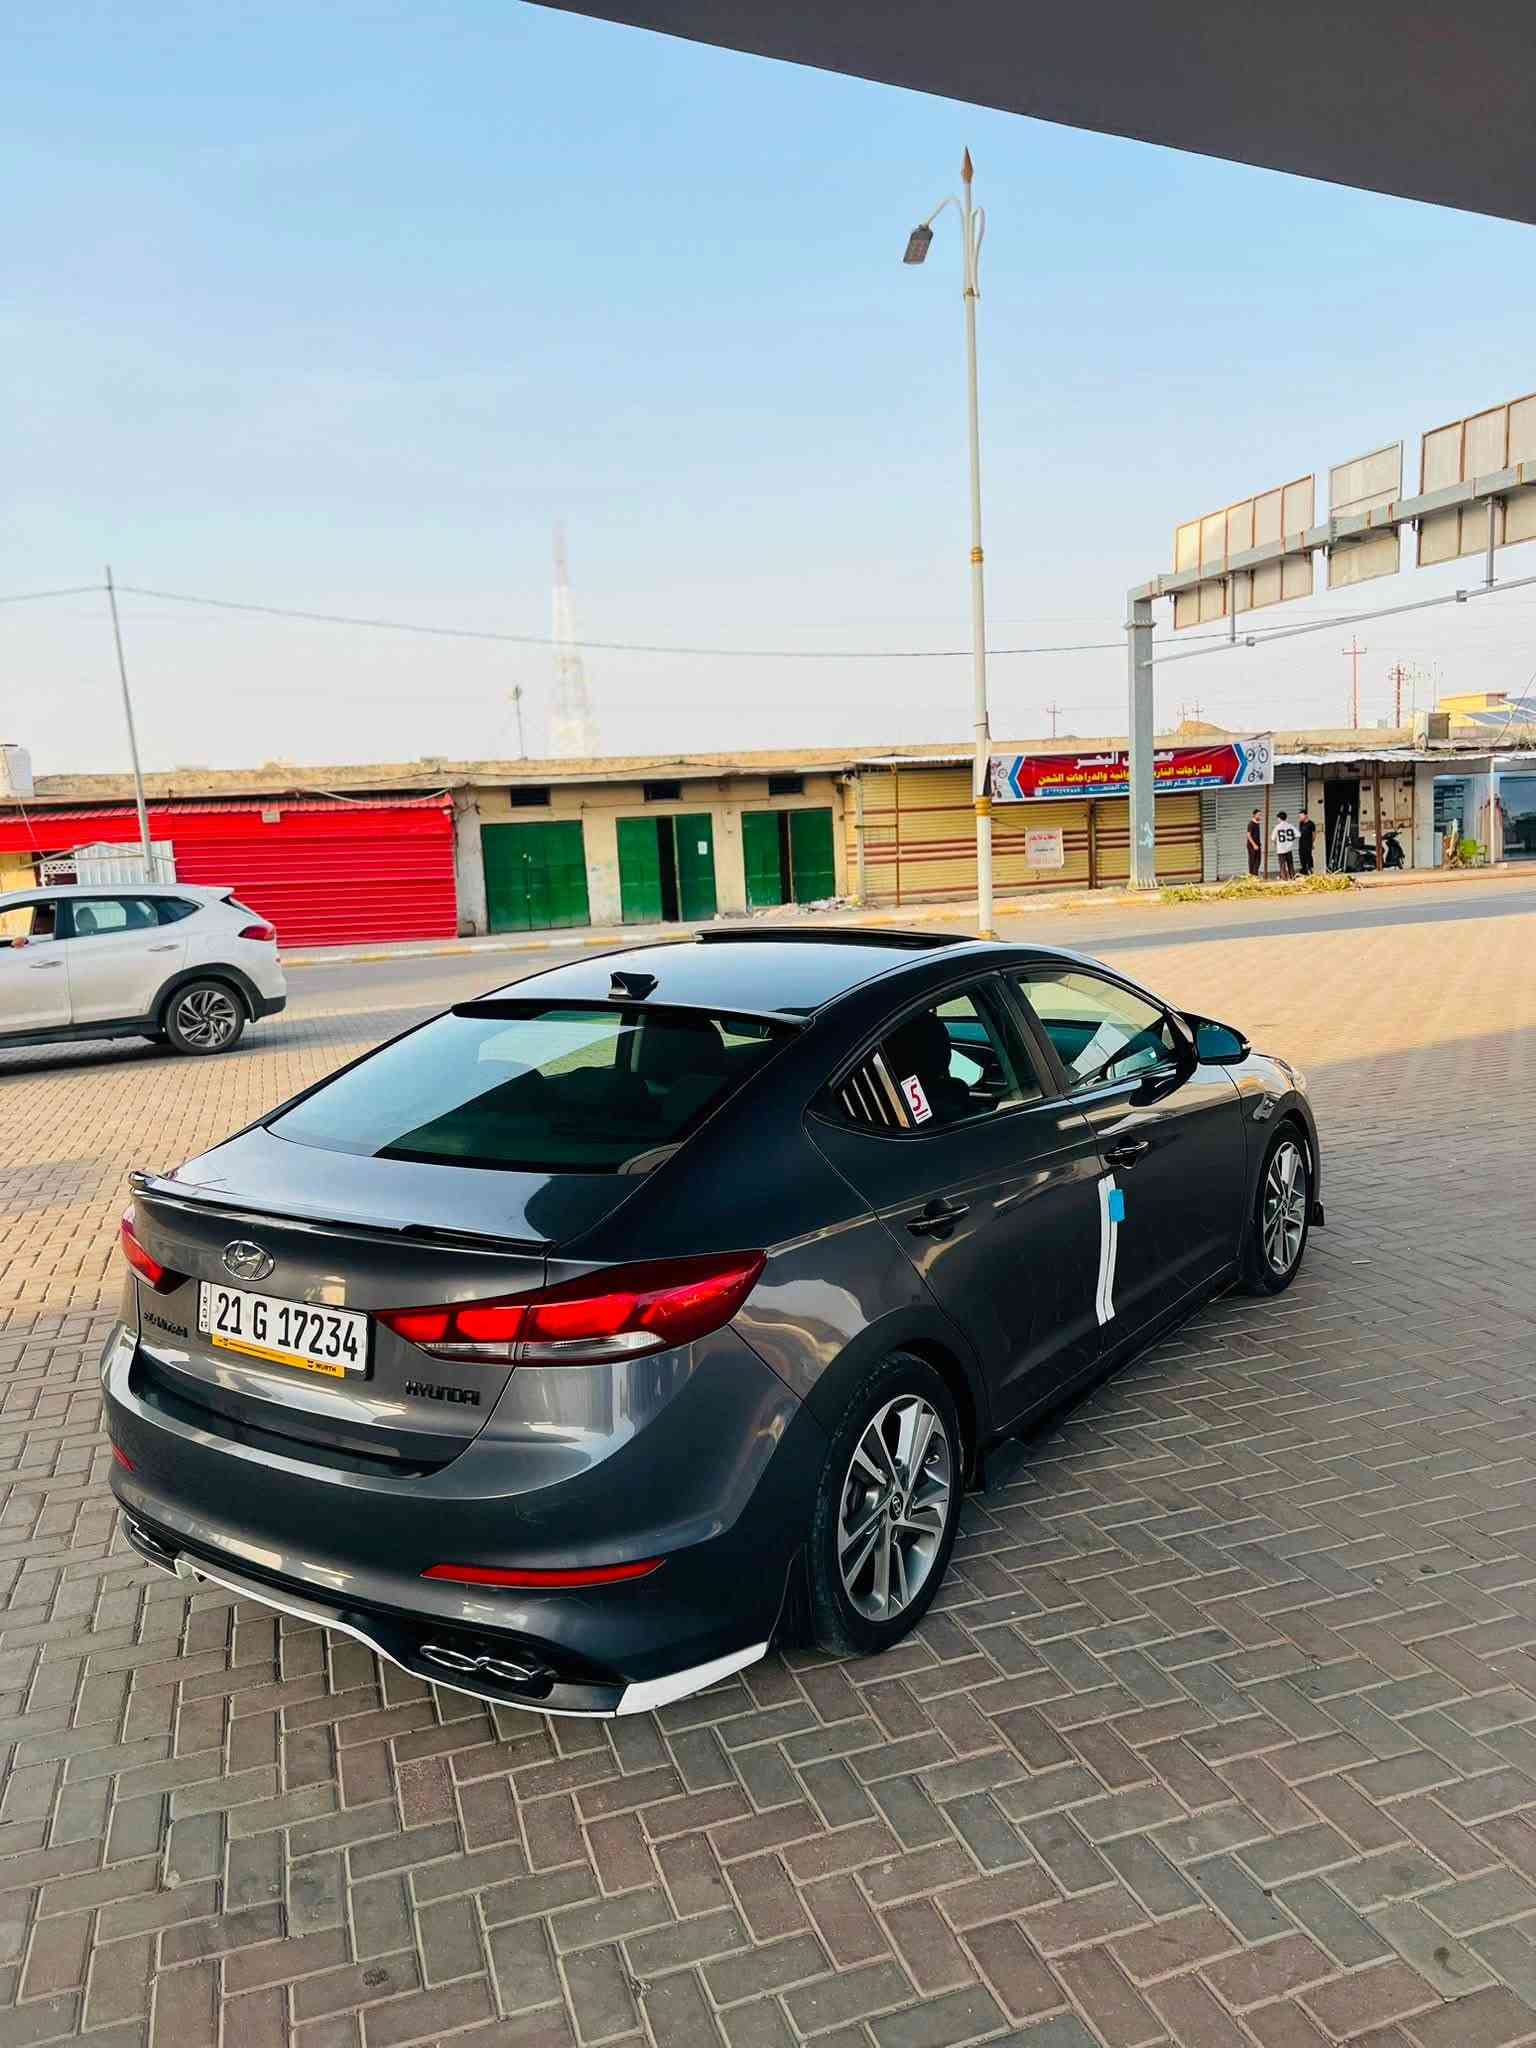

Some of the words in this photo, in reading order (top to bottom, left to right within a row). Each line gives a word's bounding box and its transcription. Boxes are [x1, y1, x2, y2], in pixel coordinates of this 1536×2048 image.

[1277, 829, 1295, 843] 69
[910, 1083, 922, 1111] 5
[216, 1292, 243, 1335] 21
[253, 1300, 268, 1342] G
[277, 1306, 358, 1362] 17234
[405, 1379, 481, 1406] HYUNDAI
